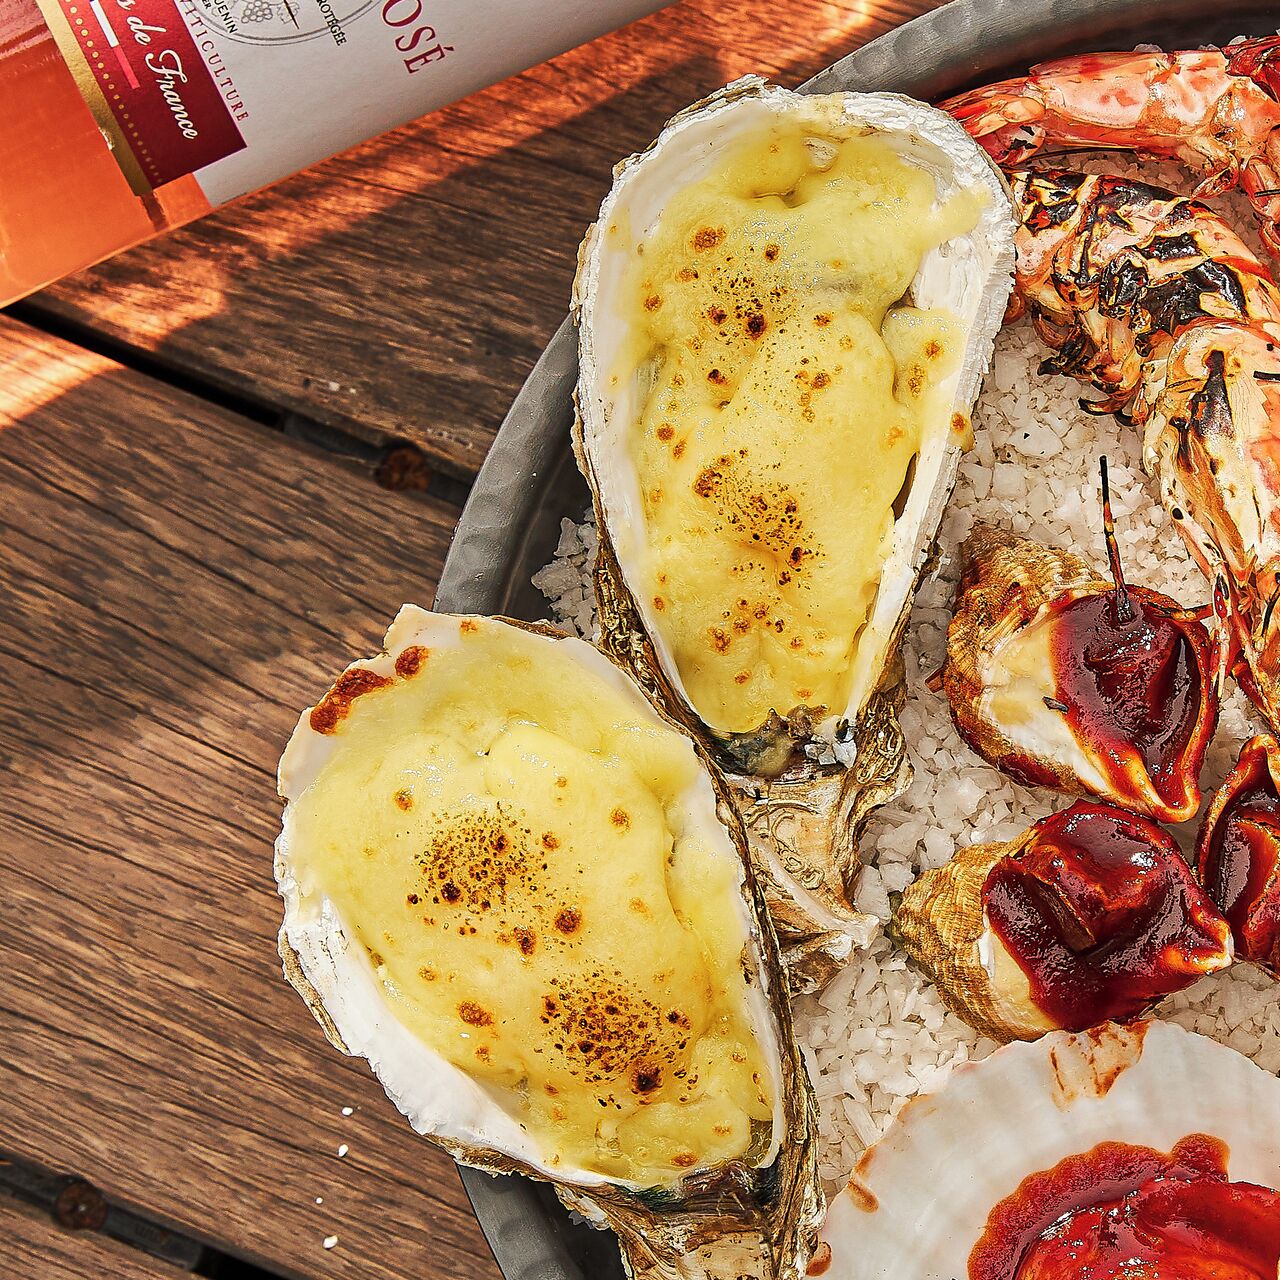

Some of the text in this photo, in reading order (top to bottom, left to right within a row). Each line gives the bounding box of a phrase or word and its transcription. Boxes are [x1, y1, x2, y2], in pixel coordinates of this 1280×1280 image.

[127, 16, 166, 46] de
[214, 0, 238, 34] JENIN
[145, 49, 198, 140] France
